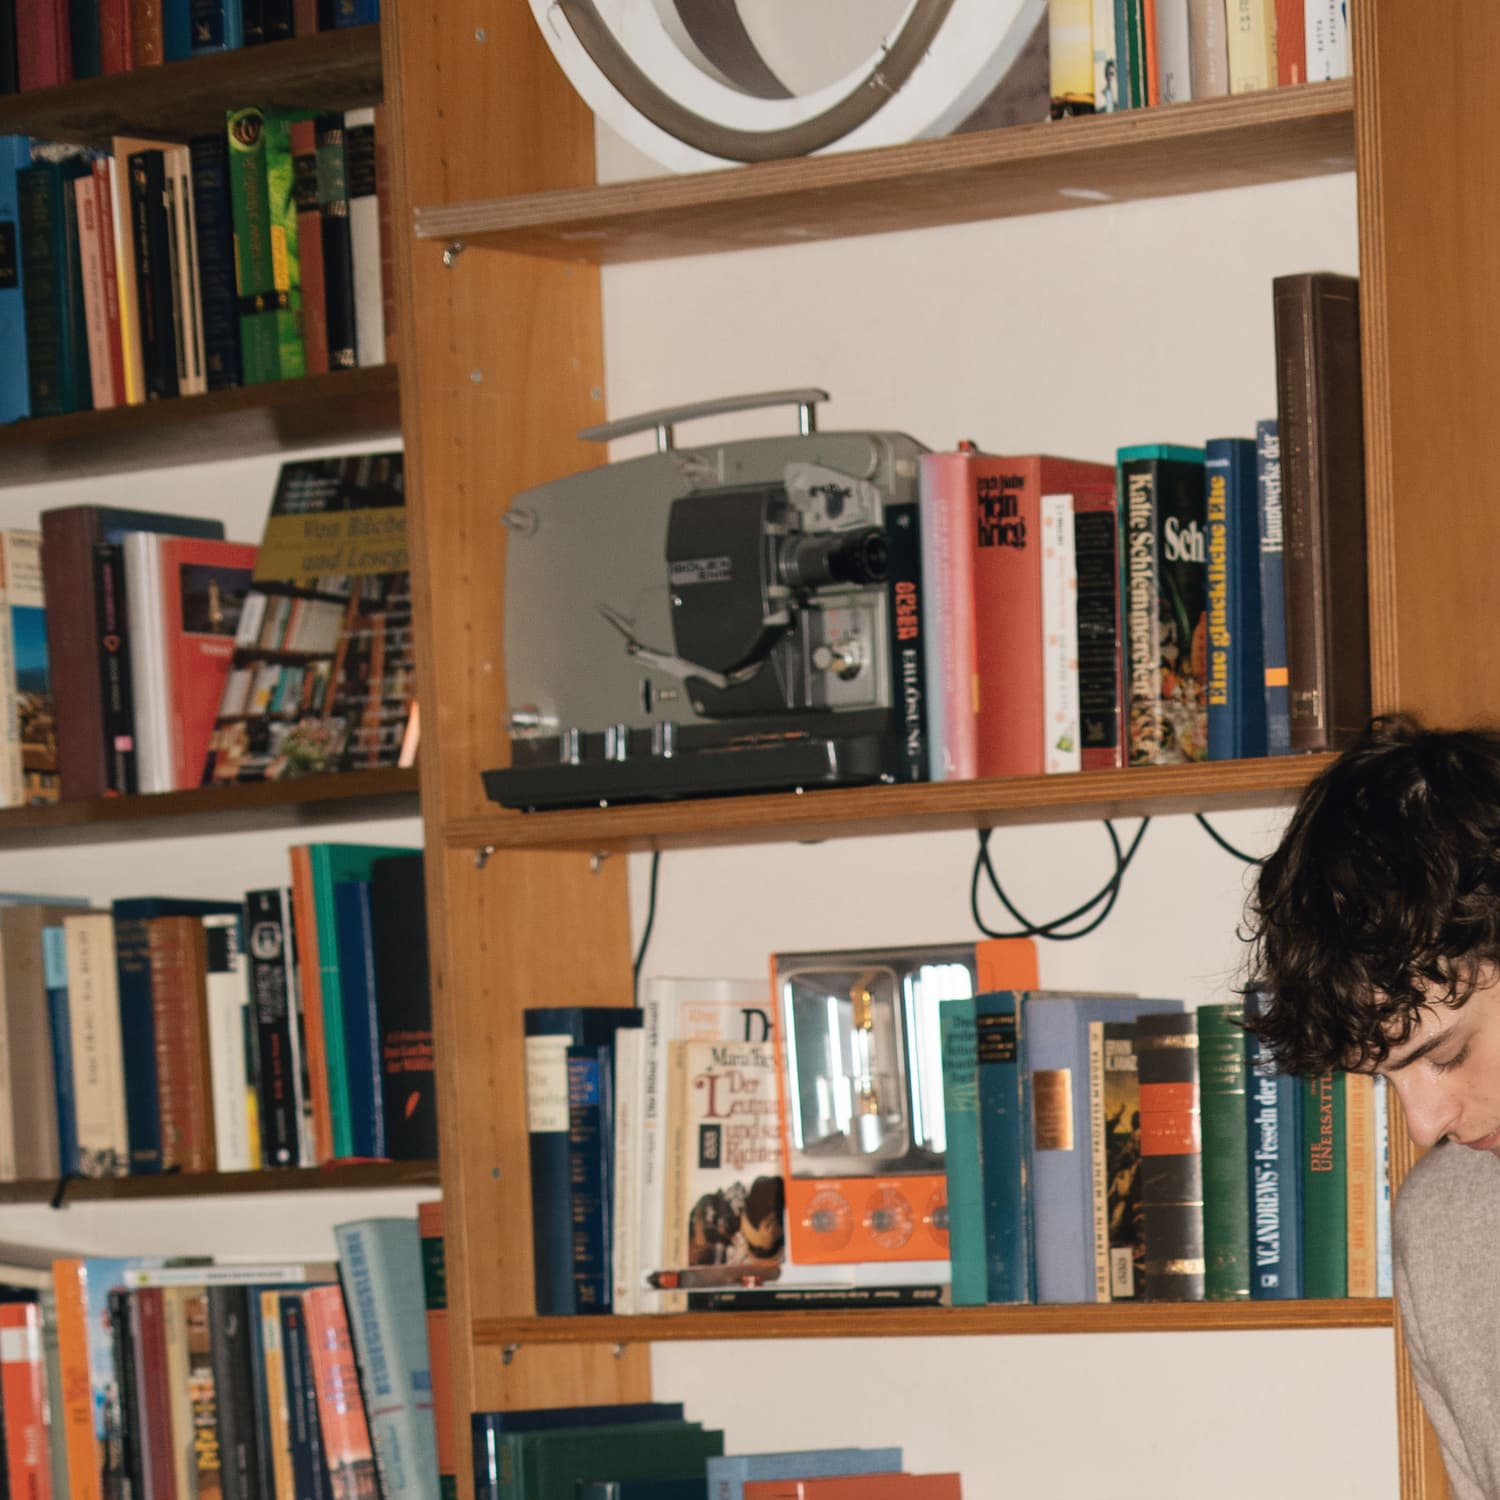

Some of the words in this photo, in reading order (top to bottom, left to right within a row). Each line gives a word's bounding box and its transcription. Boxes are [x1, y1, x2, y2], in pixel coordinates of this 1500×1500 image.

[1127, 471, 1153, 530] Kalte
[1207, 474, 1228, 521] Ehe
[1207, 524, 1232, 648] glückliche
[1128, 531, 1155, 699] Schlemmereien
[902, 648, 922, 756] ERLÖSUNG
[1208, 651, 1228, 706] Eine
[1255, 1079, 1278, 1105] der
[1256, 1109, 1279, 1160] Fesseln
[1311, 1143, 1322, 1172] DIE
